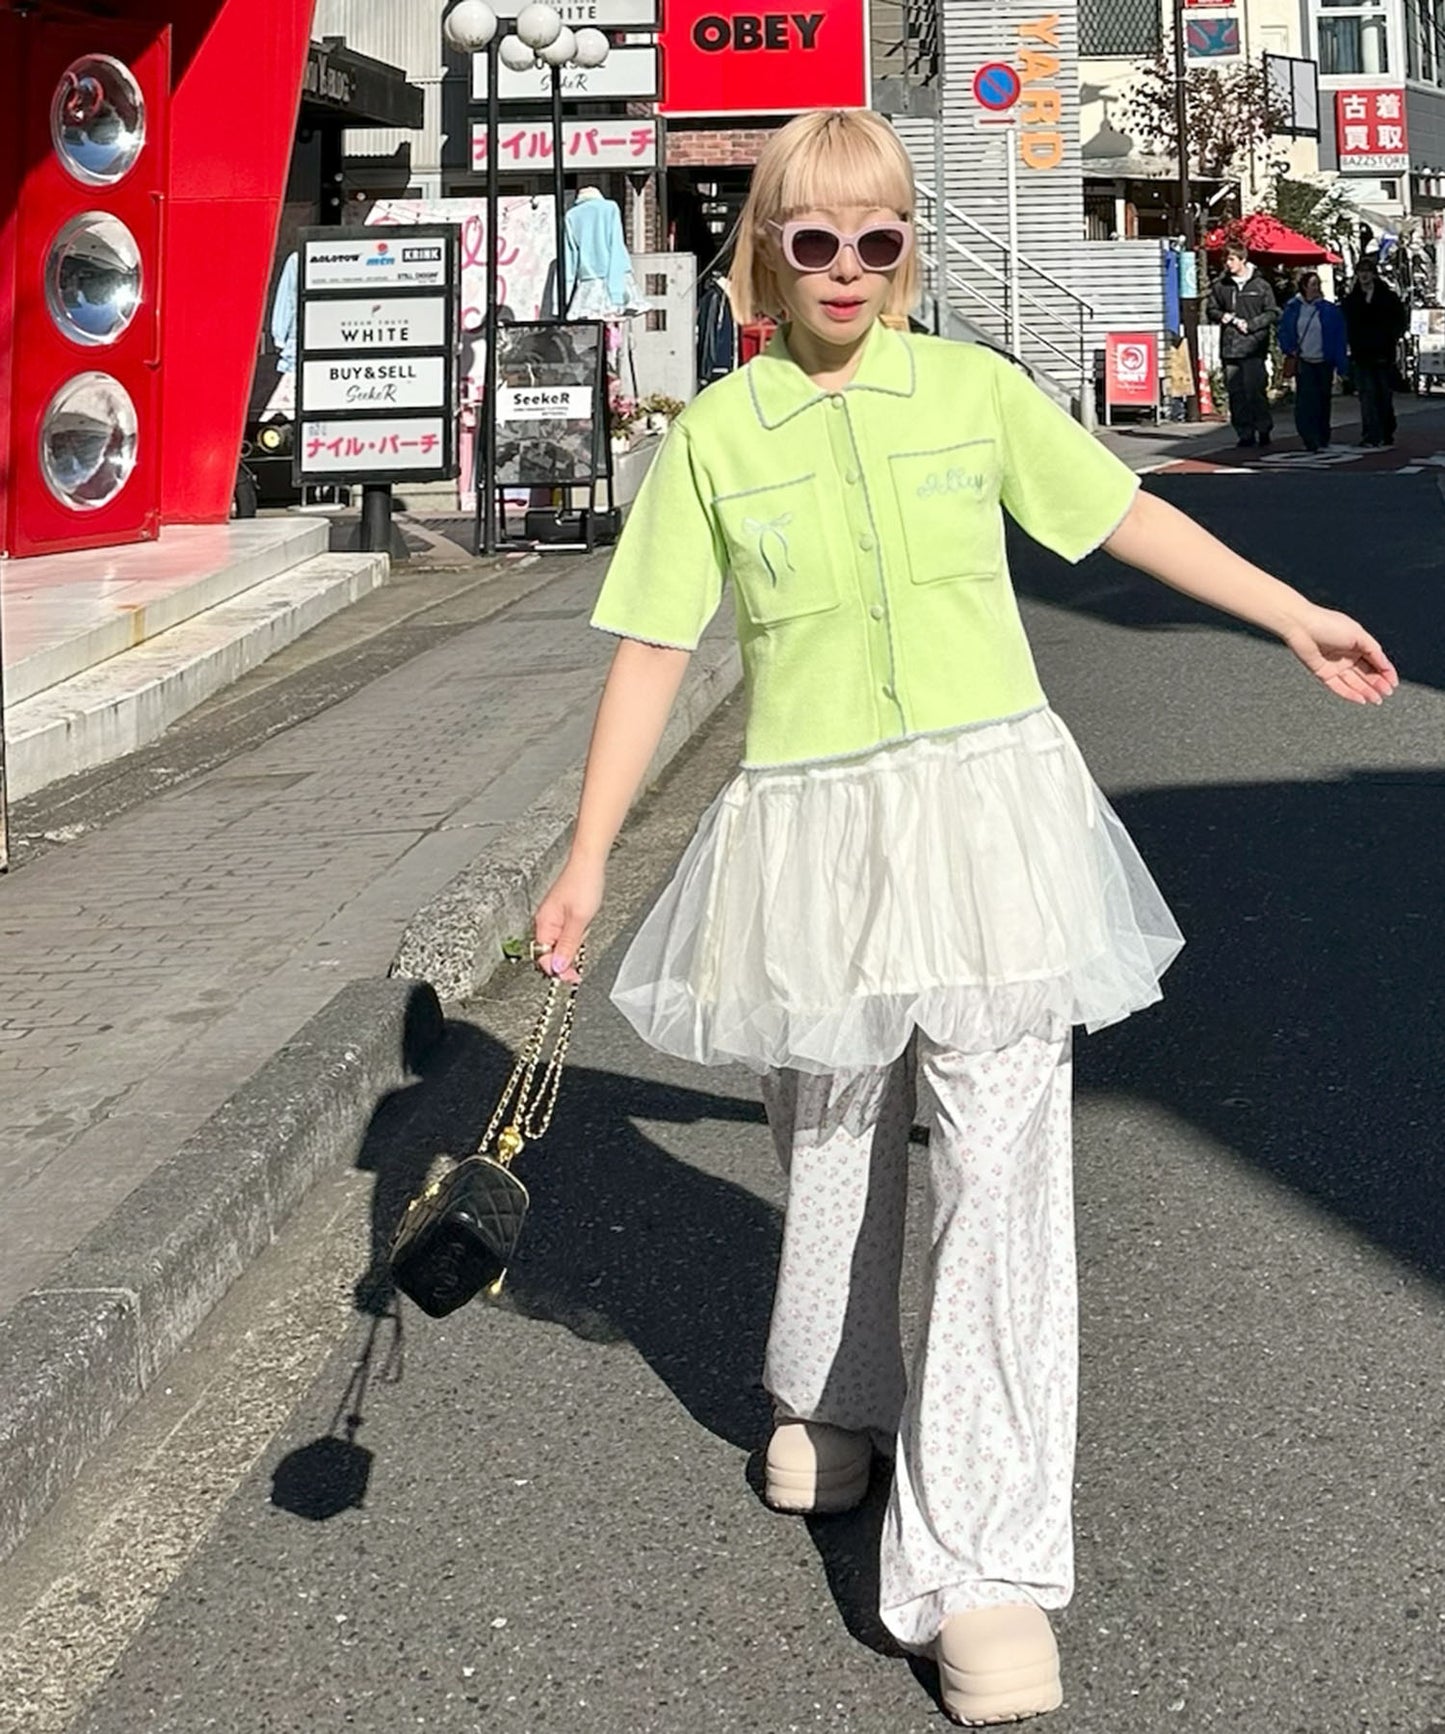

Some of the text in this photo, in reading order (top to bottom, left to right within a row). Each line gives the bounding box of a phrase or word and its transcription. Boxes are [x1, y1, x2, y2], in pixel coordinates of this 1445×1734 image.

[693, 14, 826, 52] OBEY
[1017, 12, 1064, 169] YARD
[1342, 93, 1401, 119] 古着
[472, 128, 655, 160] ナイルパーチ
[1344, 125, 1403, 151] 買取
[404, 249, 439, 260] KRINK
[341, 328, 409, 342] WHITE
[329, 365, 417, 380] BUY&SELL
[513, 392, 570, 405] SeekeR
